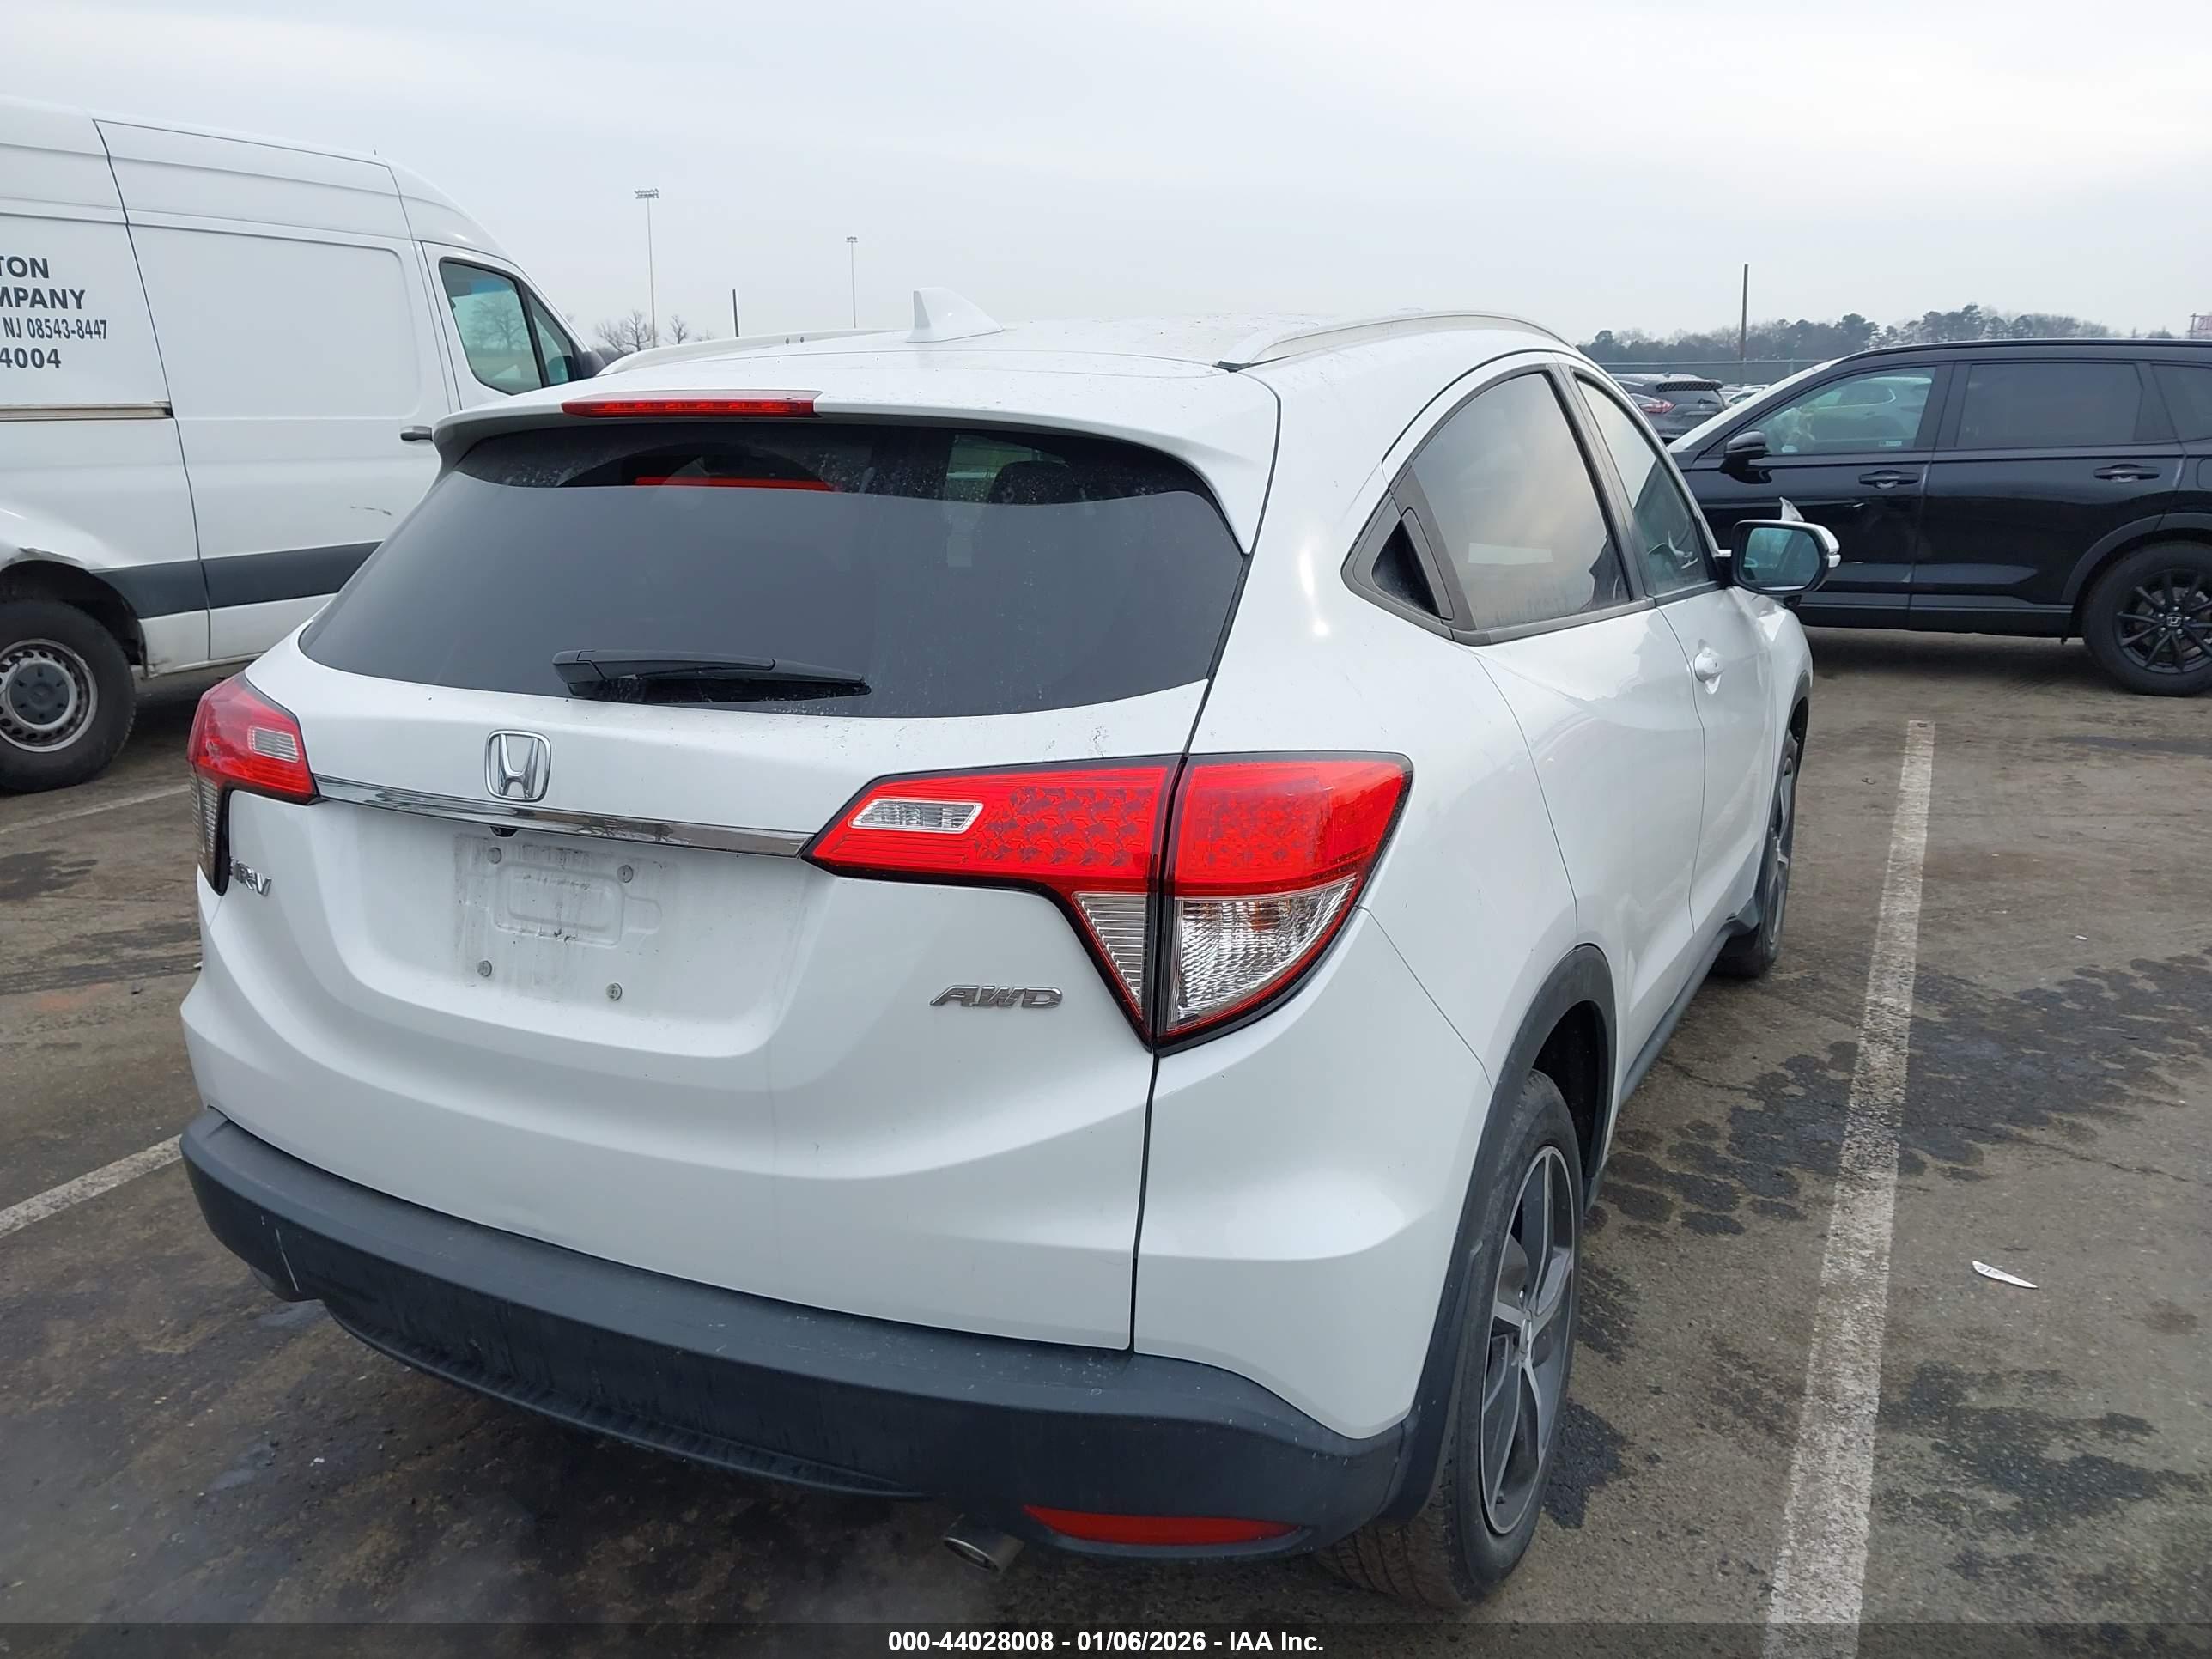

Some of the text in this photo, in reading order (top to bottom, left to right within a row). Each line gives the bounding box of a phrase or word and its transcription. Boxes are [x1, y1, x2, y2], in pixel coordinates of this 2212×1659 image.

[2, 317, 107, 339] NJ 08543-8447
[929, 985, 1063, 1008] AWD
